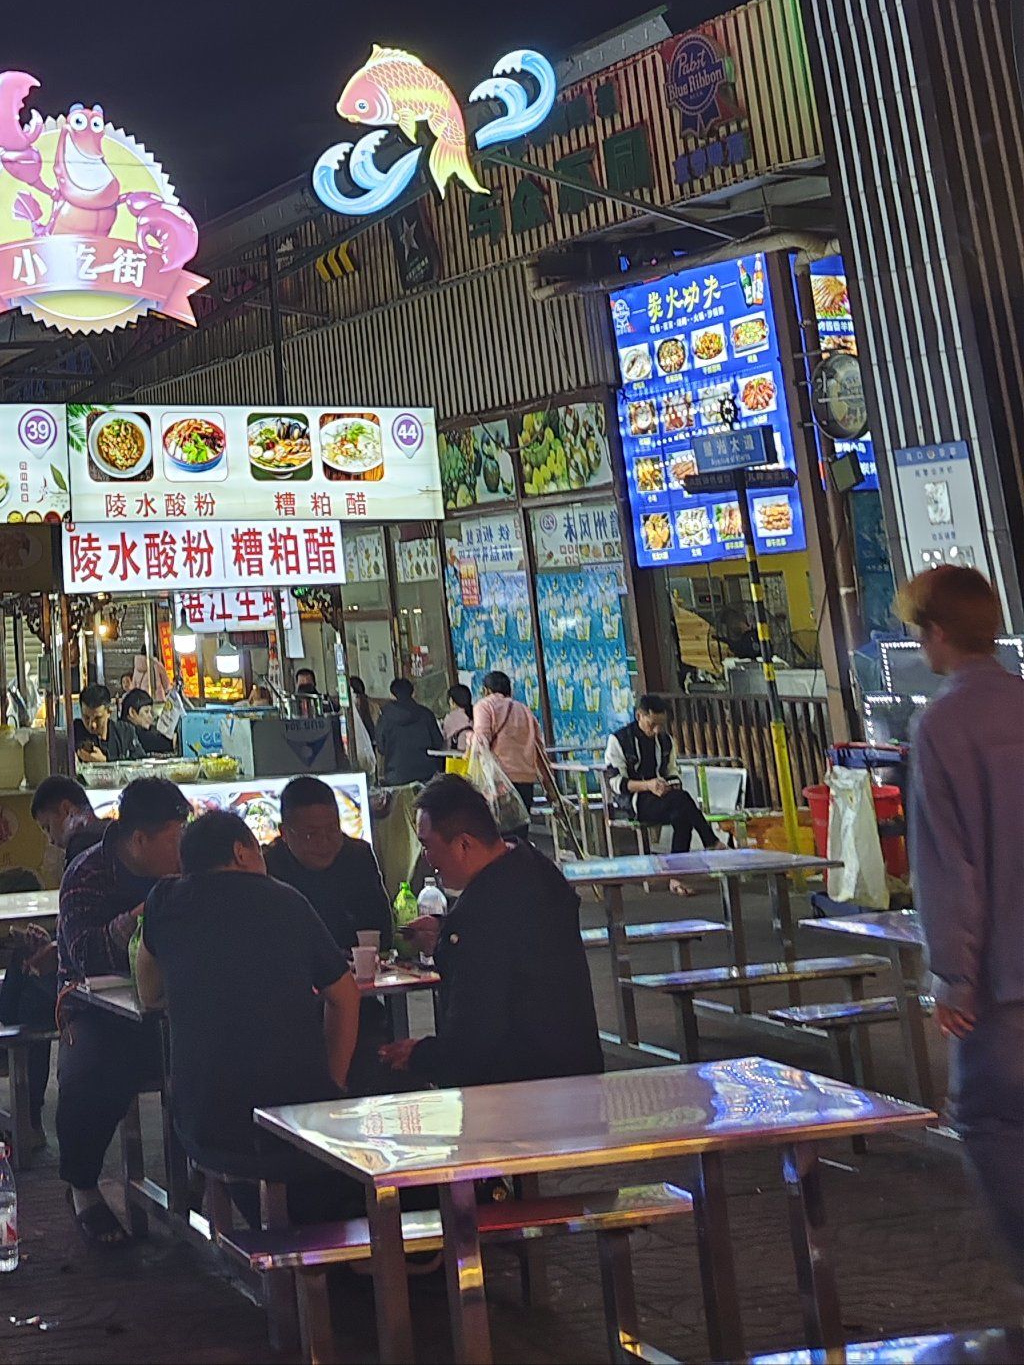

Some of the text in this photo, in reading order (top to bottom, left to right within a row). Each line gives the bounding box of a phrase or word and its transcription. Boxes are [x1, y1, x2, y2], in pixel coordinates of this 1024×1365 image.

[677, 49, 707, 77] Pabst
[668, 68, 724, 102] Blue Ribbon
[12, 243, 148, 288] 小吃街
[27, 420, 50, 441] 39
[397, 424, 418, 440] 44
[105, 491, 368, 518] 陵水酸粉 糟粕醋
[69, 525, 337, 583] 陵水酸粉 糟粕醋
